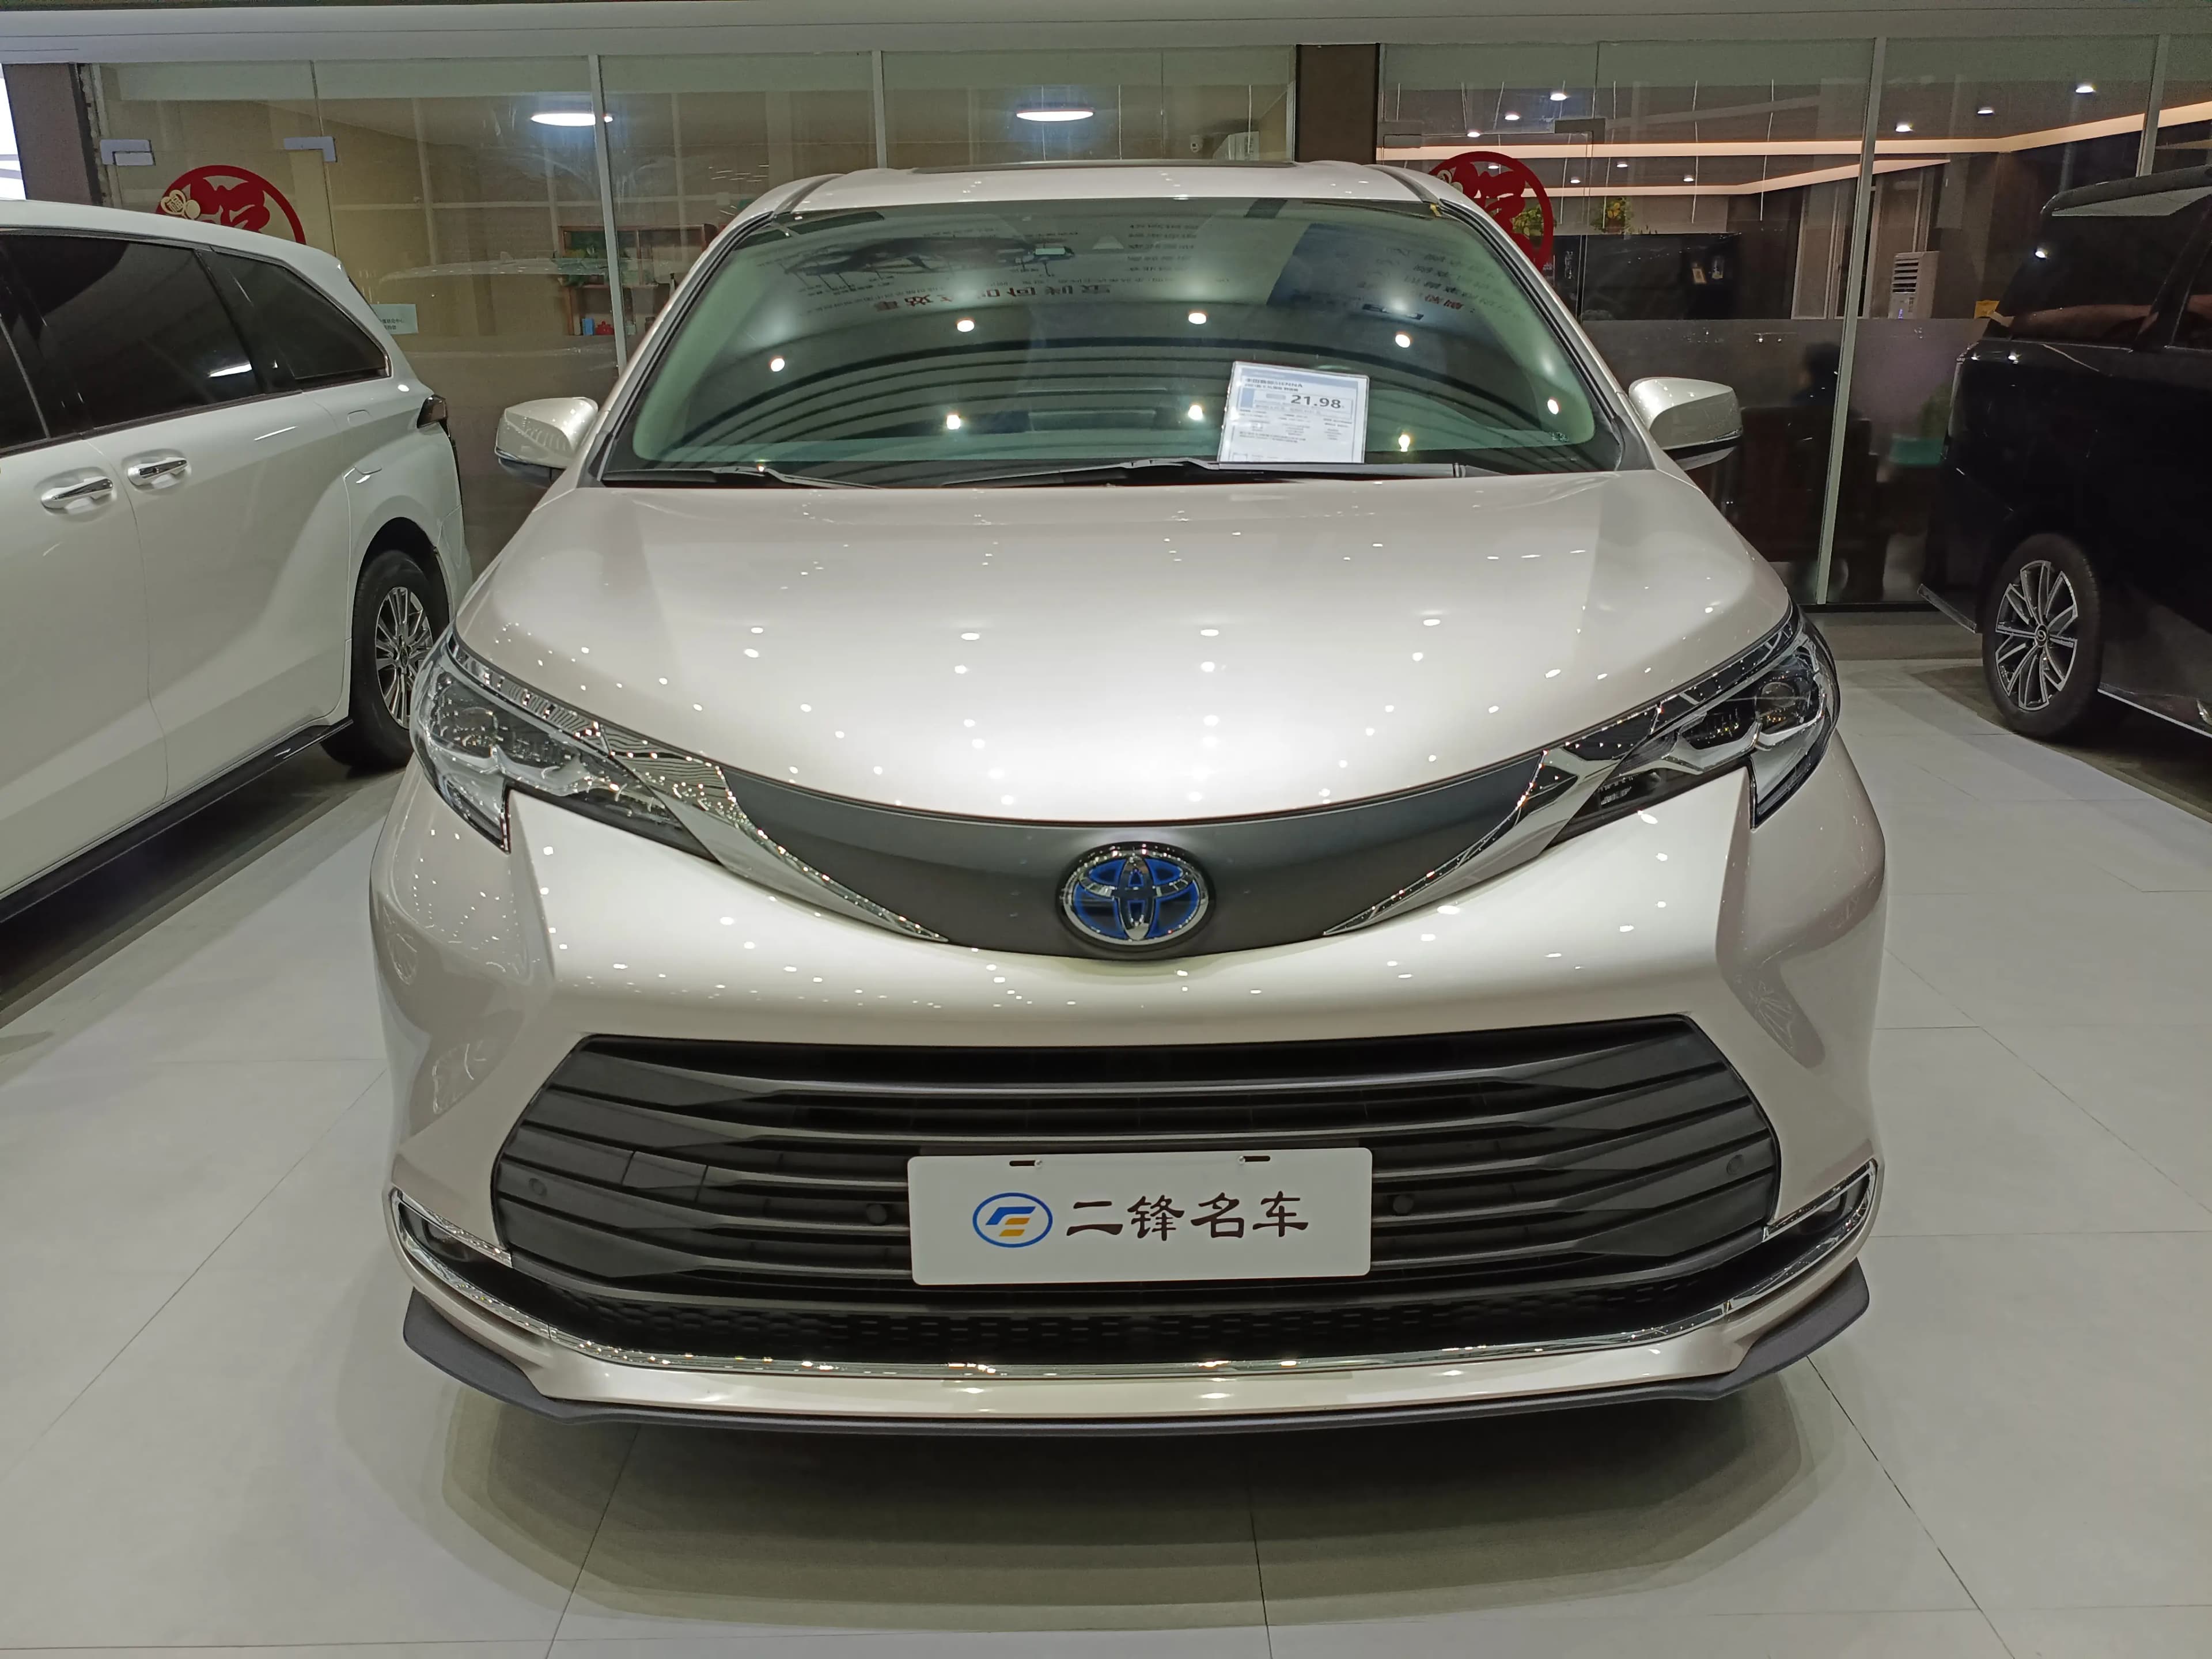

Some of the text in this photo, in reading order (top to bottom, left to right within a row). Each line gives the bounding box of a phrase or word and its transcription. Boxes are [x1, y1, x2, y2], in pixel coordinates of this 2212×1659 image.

[1291, 395, 1341, 408] 21.98
[1066, 1191, 1309, 1241] 二锋名车
